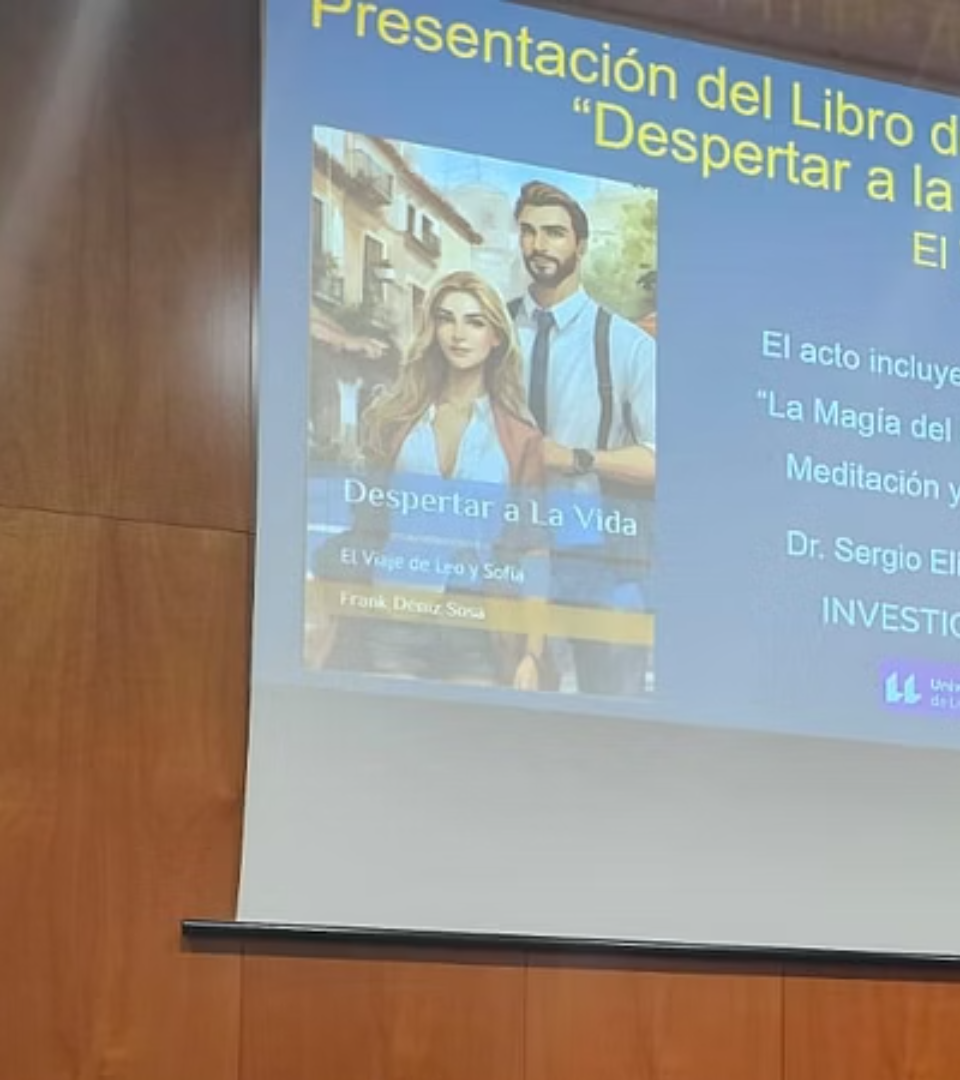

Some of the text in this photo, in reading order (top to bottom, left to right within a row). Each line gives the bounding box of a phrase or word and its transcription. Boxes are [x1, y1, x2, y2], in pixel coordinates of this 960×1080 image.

[311, 0, 678, 100] Presentación
[697, 67, 772, 118] del
[792, 83, 914, 147] Libro
[572, 97, 850, 193] “Despertar
[867, 167, 895, 203] a
[914, 164, 953, 212] la
[913, 231, 947, 270] El
[763, 330, 790, 359] El
[800, 340, 860, 370] acto
[911, 413, 951, 443] del
[786, 452, 940, 500] Meditación
[343, 477, 638, 537] Despertar a La Vida
[339, 547, 357, 566] El
[362, 550, 405, 573] Viaje
[408, 556, 431, 573] de
[436, 556, 465, 576] Leo
[468, 564, 480, 582] y
[786, 530, 825, 560] Dr.
[834, 537, 922, 574] Sergio
[339, 590, 388, 610] Frank
[445, 602, 487, 621] Sosa
[931, 693, 947, 708] de
